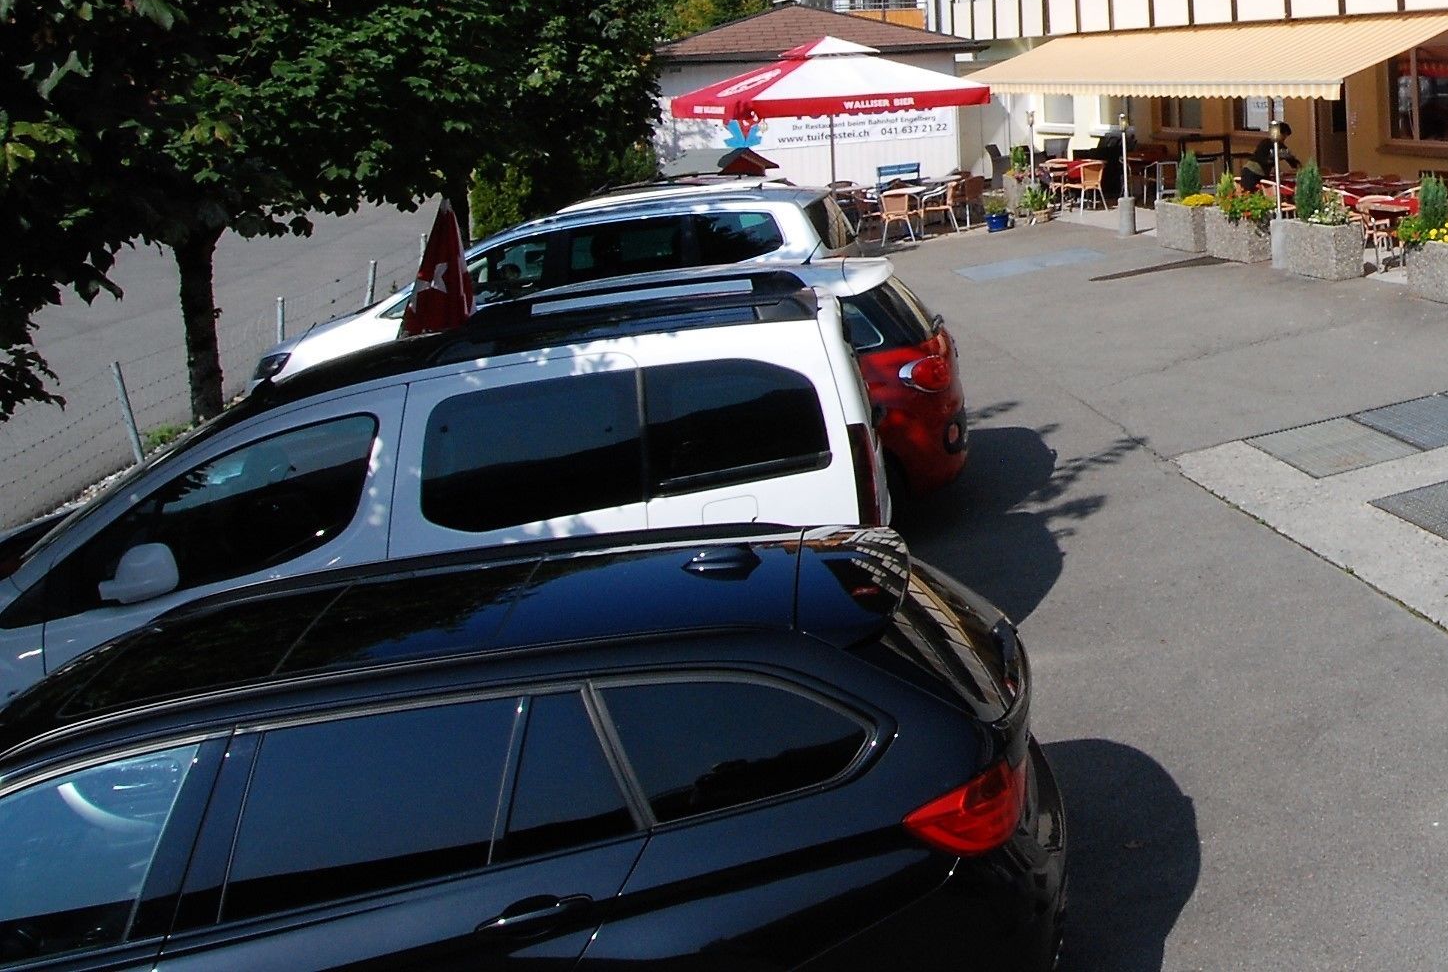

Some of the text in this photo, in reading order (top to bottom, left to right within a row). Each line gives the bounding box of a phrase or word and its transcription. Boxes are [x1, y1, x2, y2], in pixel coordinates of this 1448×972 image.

[843, 97, 915, 110] WALLISER BIER
[806, 121, 845, 129] Restauant
[847, 119, 866, 127] beim
[868, 117, 898, 126] Bahnhof
[900, 115, 936, 124] Engelberg
[778, 129, 870, 142] www.tuifesstei.ch
[881, 127, 898, 135] 041
[901, 125, 919, 133] 637
[936, 123, 947, 131] 22
